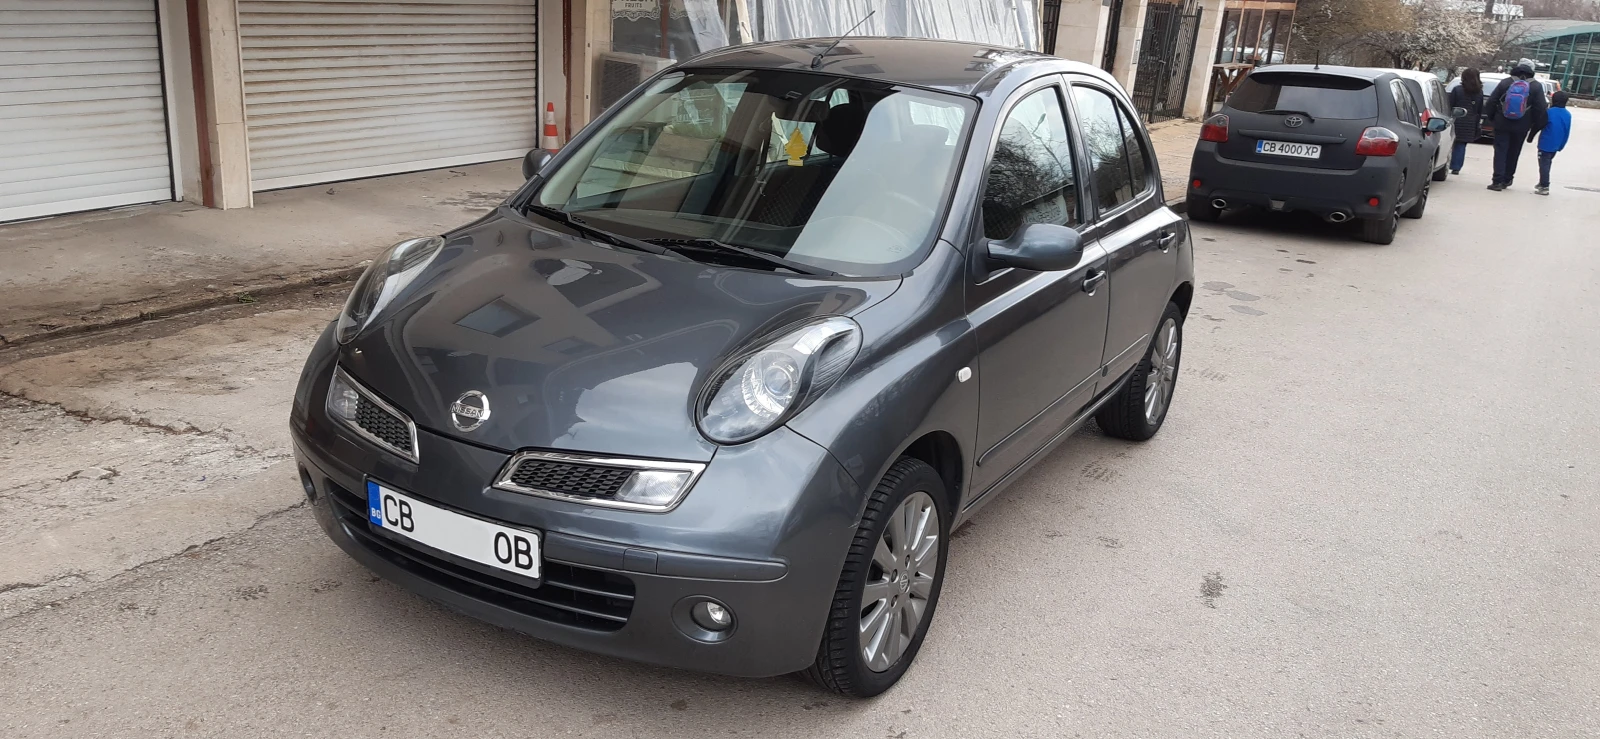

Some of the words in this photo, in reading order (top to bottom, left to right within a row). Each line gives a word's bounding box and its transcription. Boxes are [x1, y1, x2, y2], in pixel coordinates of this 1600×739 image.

[1263, 142, 1276, 152] CB
[1278, 144, 1302, 155] 4000
[1304, 146, 1318, 156] XP
[451, 402, 484, 418] NISSAN
[371, 507, 382, 519] BG
[383, 494, 414, 532] CB
[494, 531, 533, 570] OB
